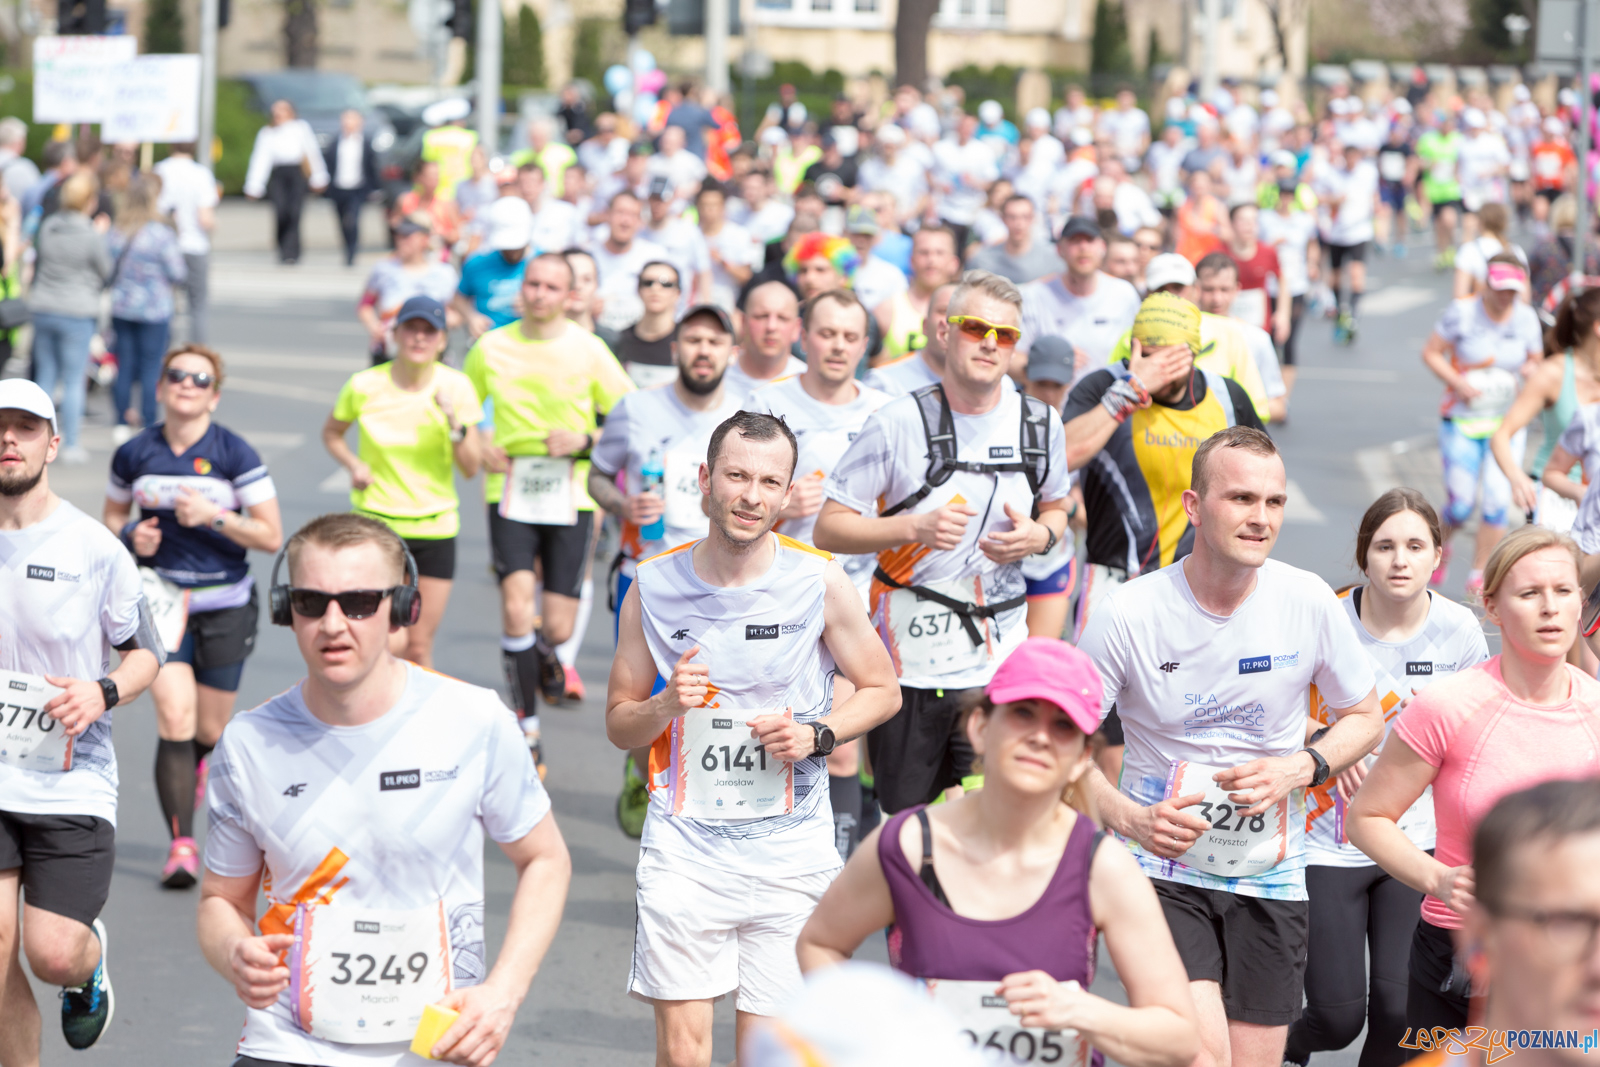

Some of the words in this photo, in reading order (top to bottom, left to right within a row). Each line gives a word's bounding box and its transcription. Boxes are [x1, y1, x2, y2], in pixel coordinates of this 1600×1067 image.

[908, 610, 964, 638] 637
[1159, 662, 1180, 673] 4F
[1184, 693, 1218, 705] SIŁA
[701, 745, 766, 772] 6141
[713, 778, 755, 787] Jarosław
[283, 783, 308, 797] 4F
[1196, 801, 1266, 833] 3278
[1208, 835, 1249, 847] Krzysztof
[330, 951, 429, 985] 3249
[360, 994, 400, 1005] Marcin
